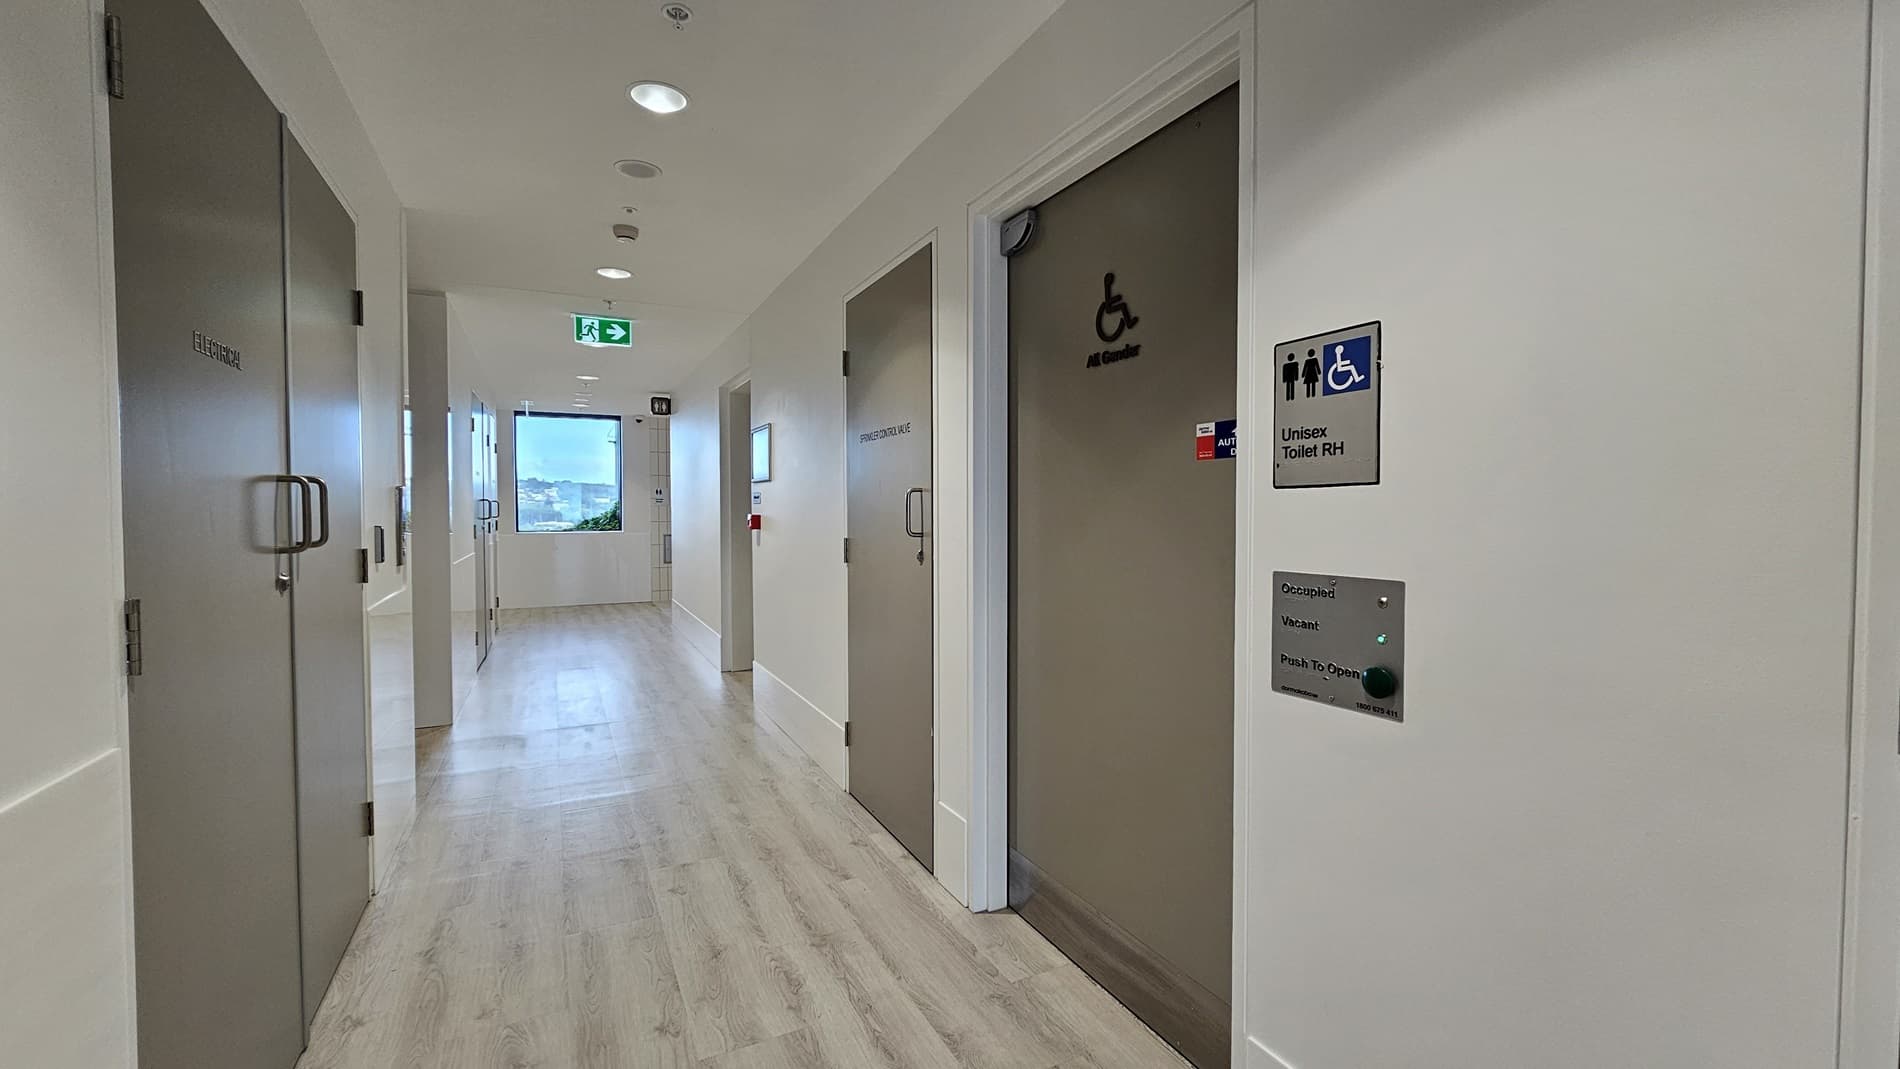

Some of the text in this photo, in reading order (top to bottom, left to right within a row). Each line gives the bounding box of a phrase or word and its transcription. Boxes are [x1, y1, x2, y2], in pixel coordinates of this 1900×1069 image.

[192, 330, 243, 371] ELECTRICAL
[1086, 344, 1141, 368] All Gender
[879, 426, 898, 440] CONTROL
[897, 422, 911, 434] VALVE
[1281, 426, 1328, 441] Unisex
[1281, 441, 1344, 459] Toilet RH
[1281, 582, 1336, 599] Occupied
[1281, 615, 1320, 631] Vacant
[1280, 653, 1361, 680] Push To Open
[1355, 702, 1372, 712] 1800
